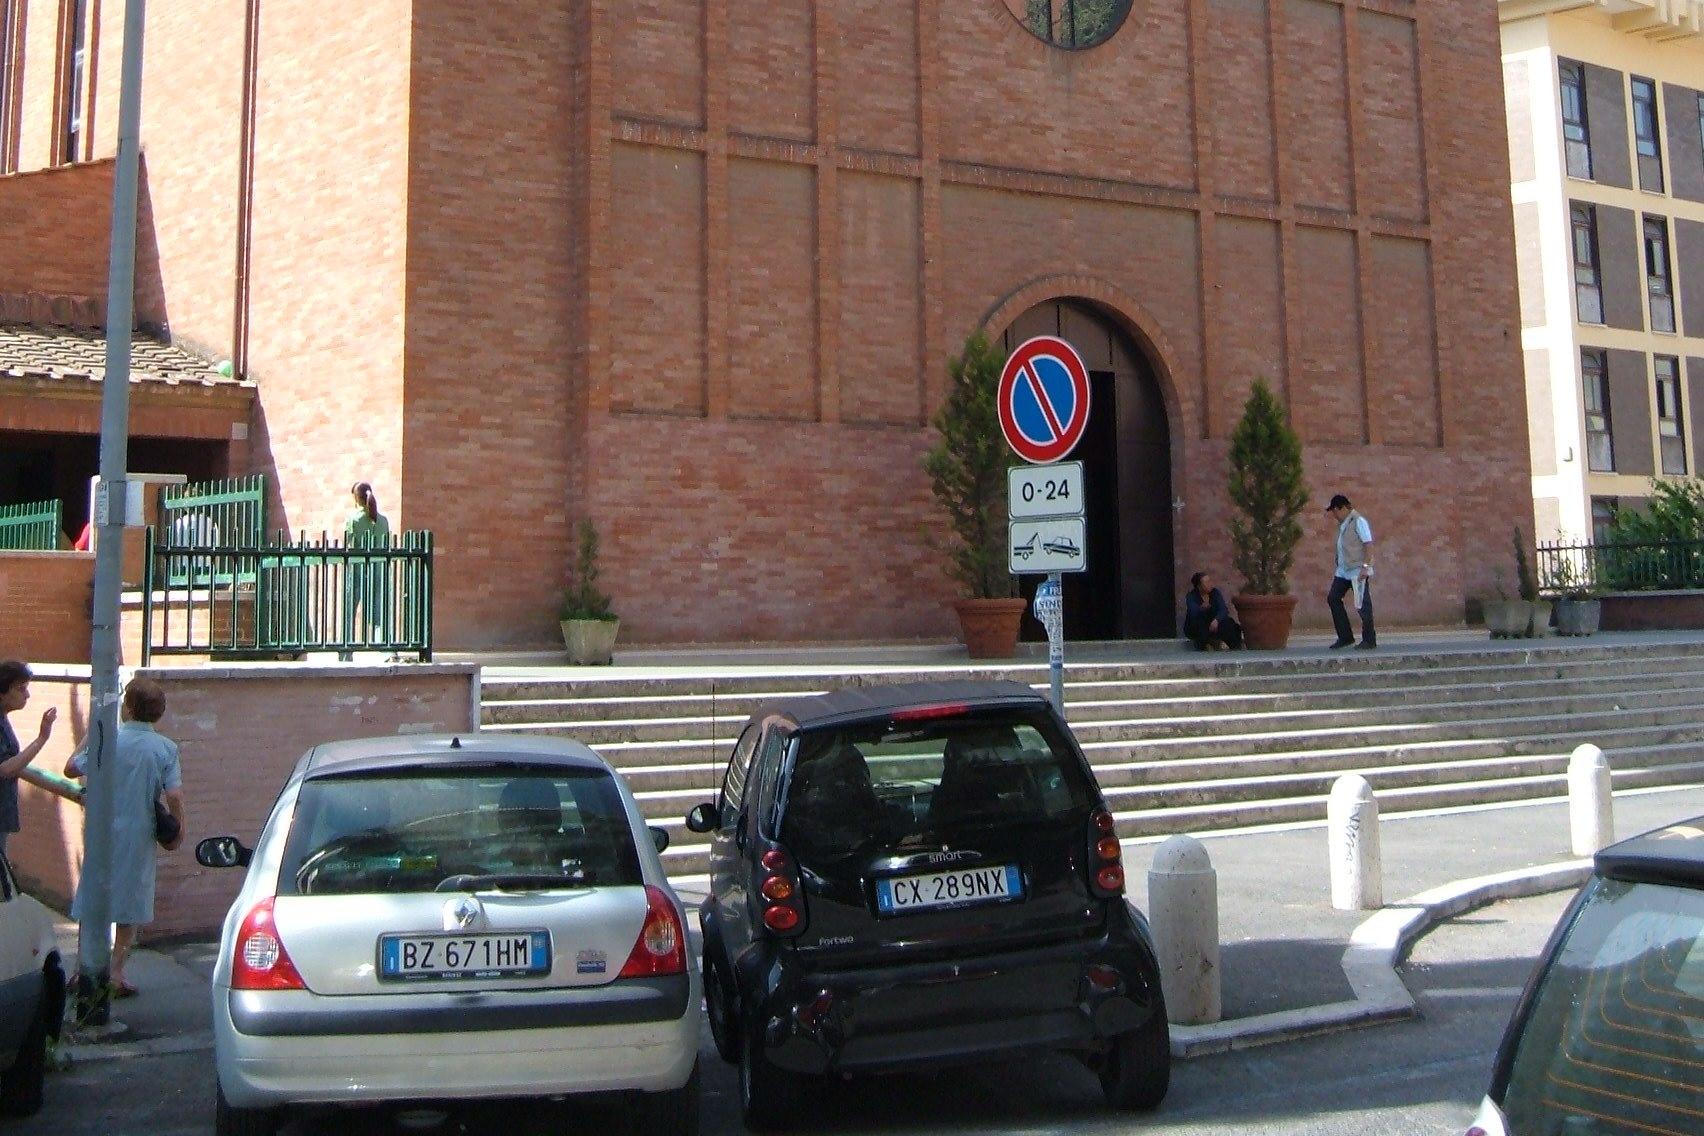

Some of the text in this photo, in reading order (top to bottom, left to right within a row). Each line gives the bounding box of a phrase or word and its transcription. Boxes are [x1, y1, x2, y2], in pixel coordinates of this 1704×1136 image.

[1021, 479, 1071, 502] 0-24
[928, 850, 962, 864] smart
[894, 879, 923, 905] CX
[932, 869, 1005, 901] 289NX
[403, 942, 435, 970] BZ
[445, 938, 528, 968] 671HM
